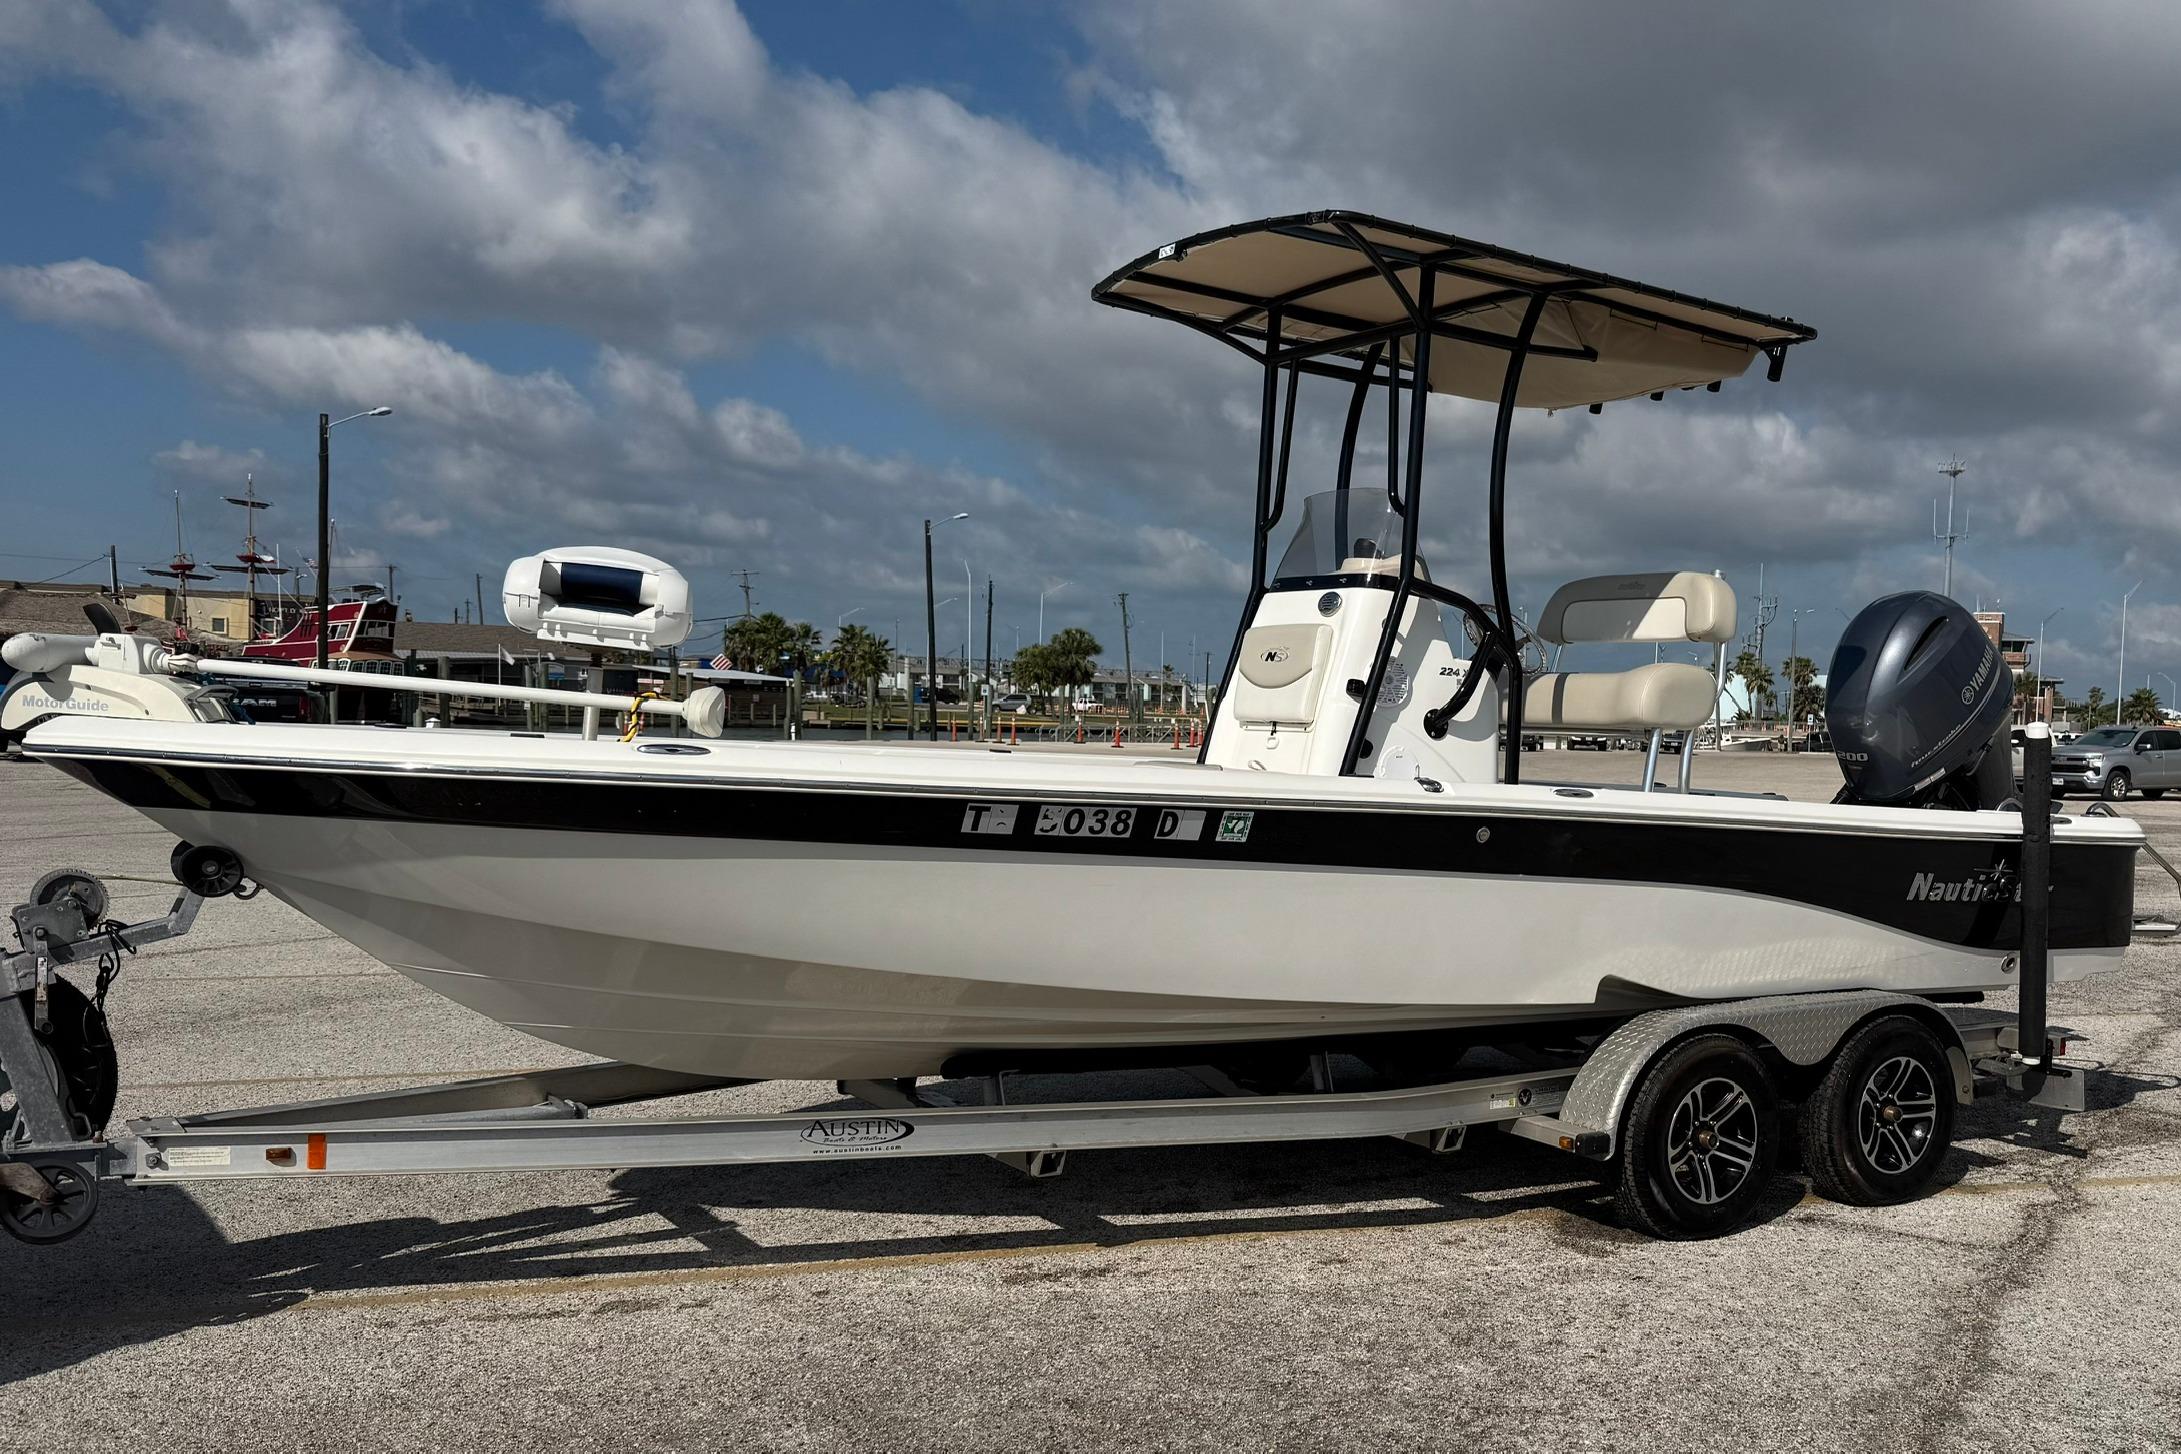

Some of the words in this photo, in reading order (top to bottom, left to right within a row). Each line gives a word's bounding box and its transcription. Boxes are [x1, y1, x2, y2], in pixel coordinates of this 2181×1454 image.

[1439, 667, 1460, 677] 224
[1970, 645, 1994, 691] YAMAHA
[22, 695, 109, 712] MotorGuide
[1837, 750, 1869, 762] 200
[807, 1120, 900, 1138] AUSTIN
[812, 1145, 902, 1154] www.austinboats.com
